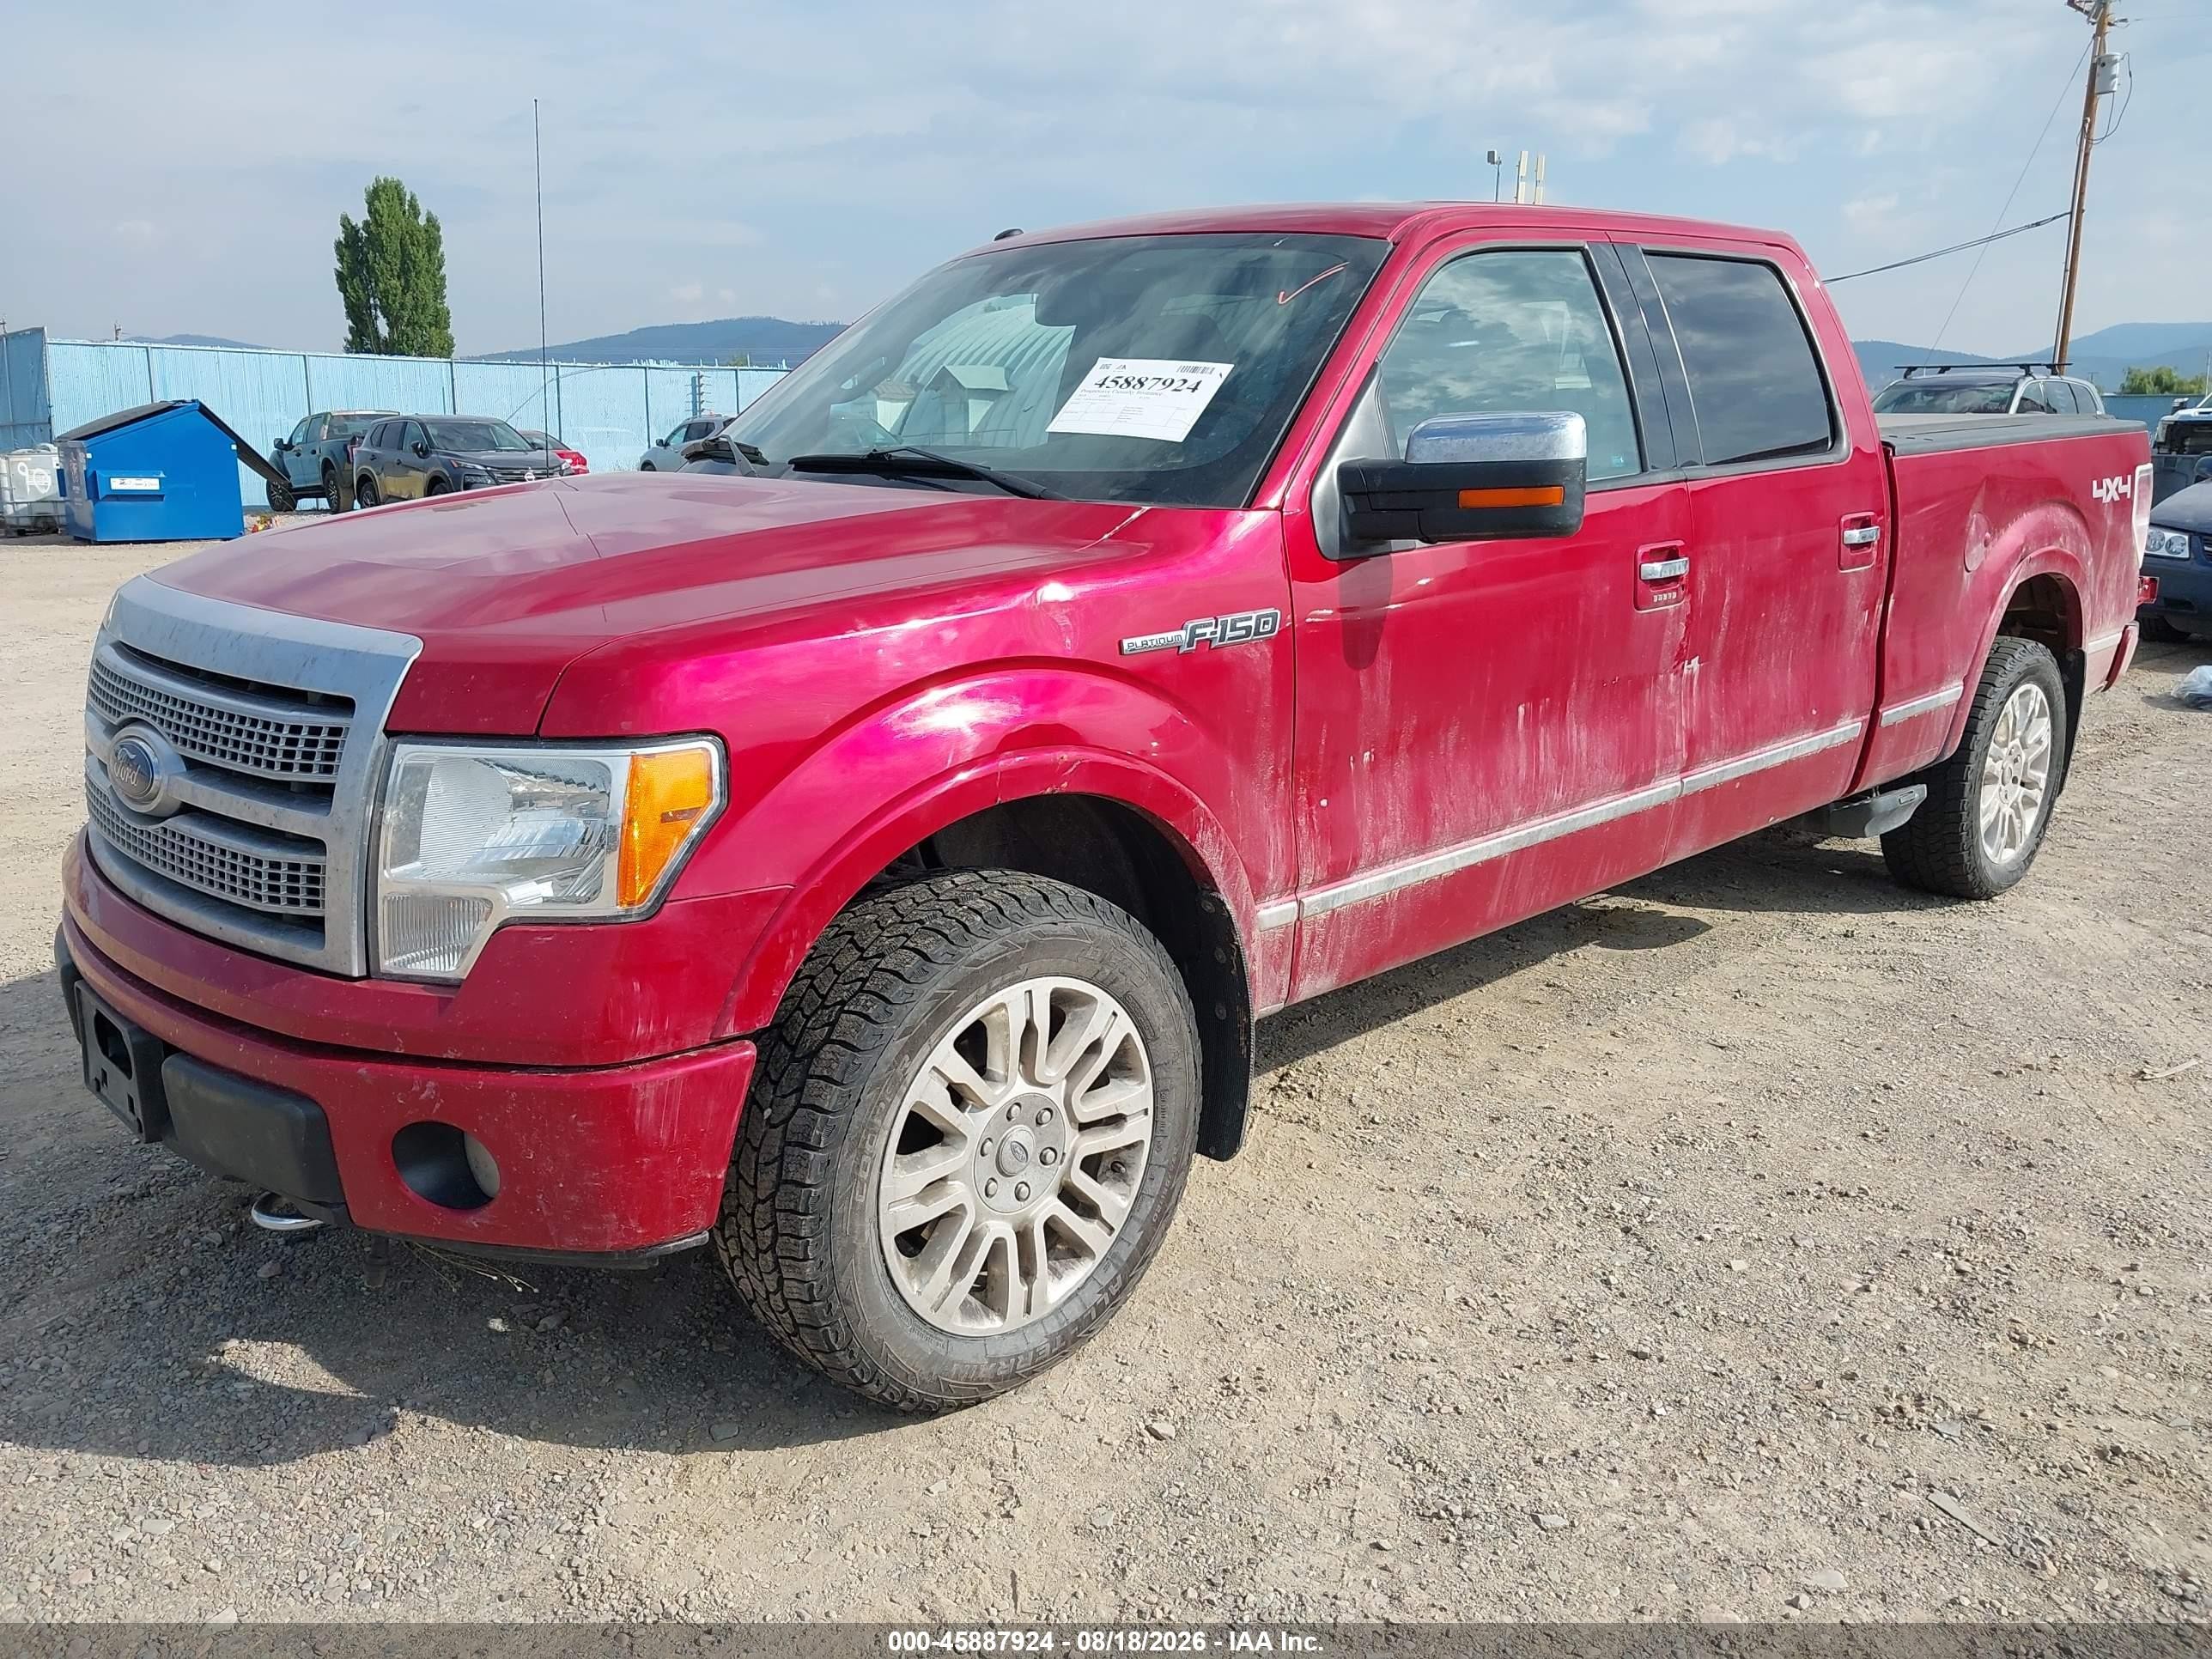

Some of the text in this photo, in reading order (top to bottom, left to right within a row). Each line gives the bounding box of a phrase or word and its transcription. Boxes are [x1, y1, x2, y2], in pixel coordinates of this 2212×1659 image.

[1095, 375, 1202, 393] 45887924
[1127, 610, 1280, 651] PLATINUM F-150
[112, 747, 141, 787] Ford
